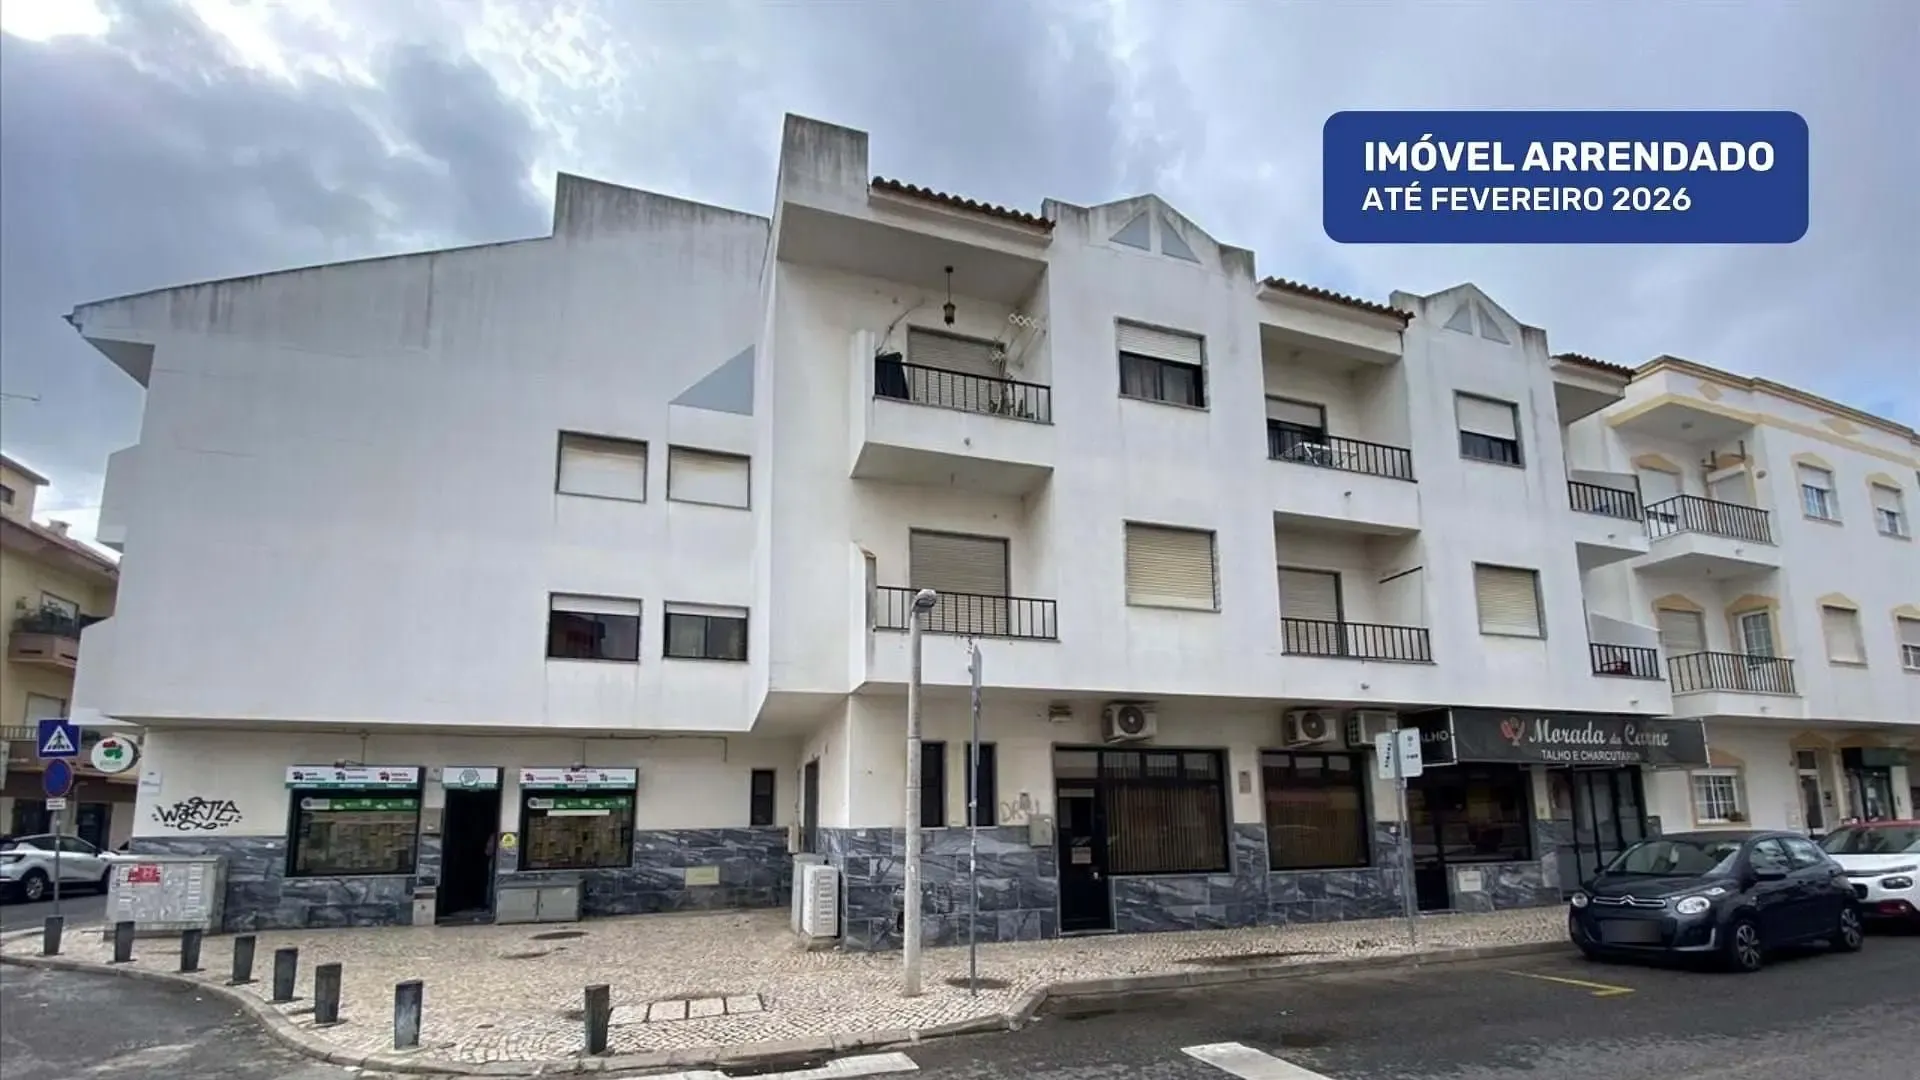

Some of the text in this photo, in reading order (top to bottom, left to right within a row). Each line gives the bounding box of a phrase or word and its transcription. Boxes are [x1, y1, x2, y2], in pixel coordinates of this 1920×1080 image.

[1529, 718, 1606, 745] Morada
[1624, 721, 1670, 746] Carne
[1541, 749, 1571, 761] TALHO
[1573, 750, 1580, 761] E
